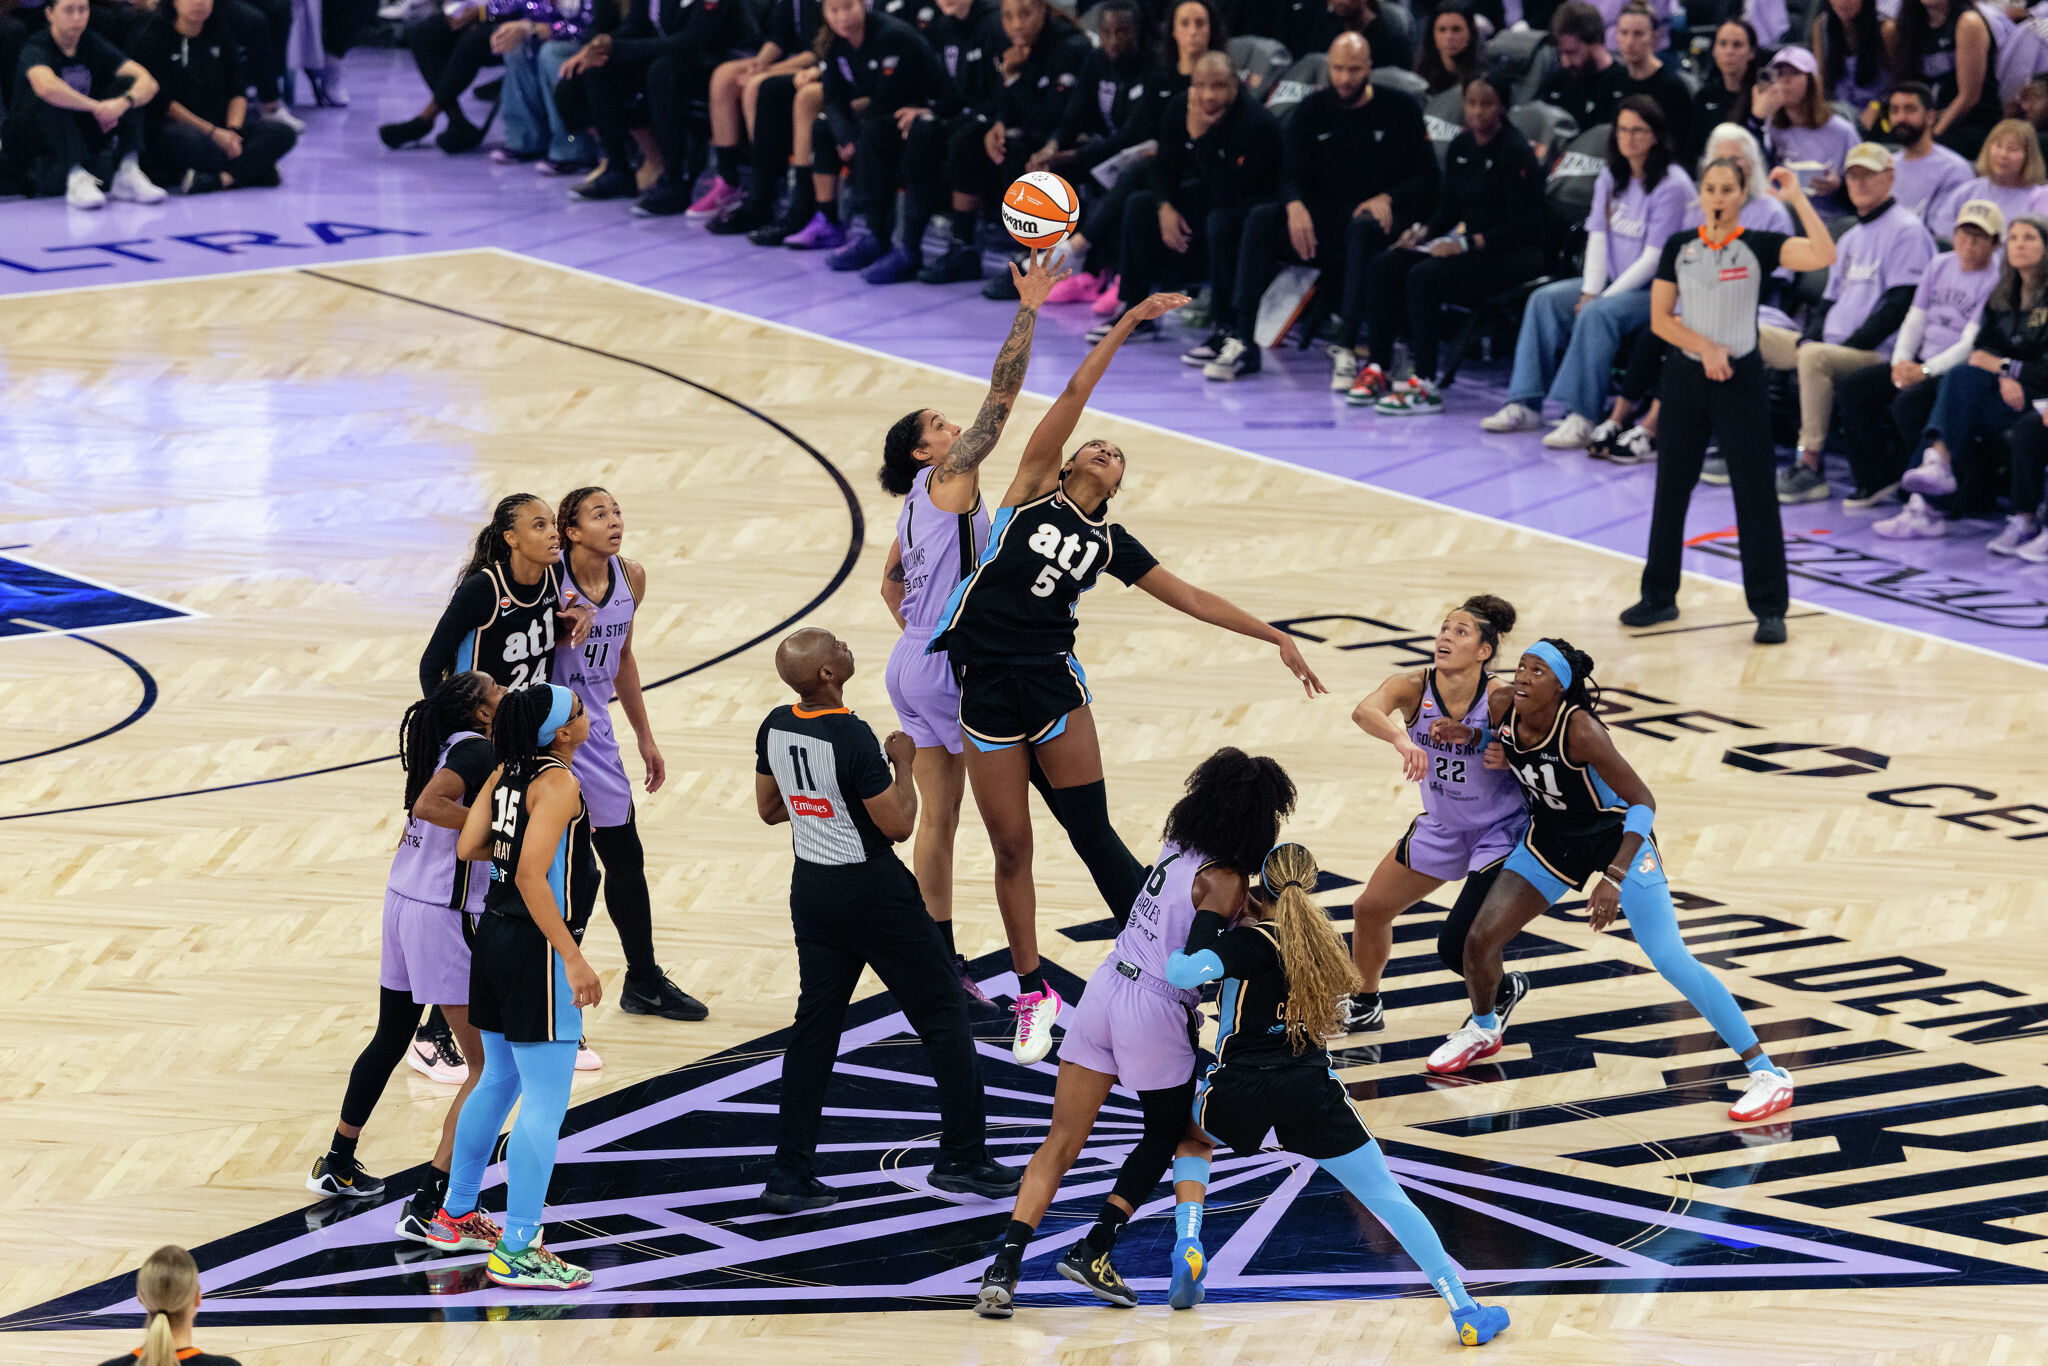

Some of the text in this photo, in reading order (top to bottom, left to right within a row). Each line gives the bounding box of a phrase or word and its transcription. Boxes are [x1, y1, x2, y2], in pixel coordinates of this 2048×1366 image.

[1028, 523, 1099, 581] atl
[912, 575, 929, 591] AT&T
[1030, 564, 1063, 598] 5
[502, 607, 556, 663] atl
[584, 642, 610, 669] 41
[507, 657, 547, 693] 24
[1267, 615, 1768, 742] CHSE
[788, 744, 817, 792] 11
[1435, 756, 1467, 784] 22
[1540, 752, 1559, 762] Albert
[491, 785, 521, 838] 15
[794, 800, 828, 813] Emirates
[1146, 851, 1182, 898] 6
